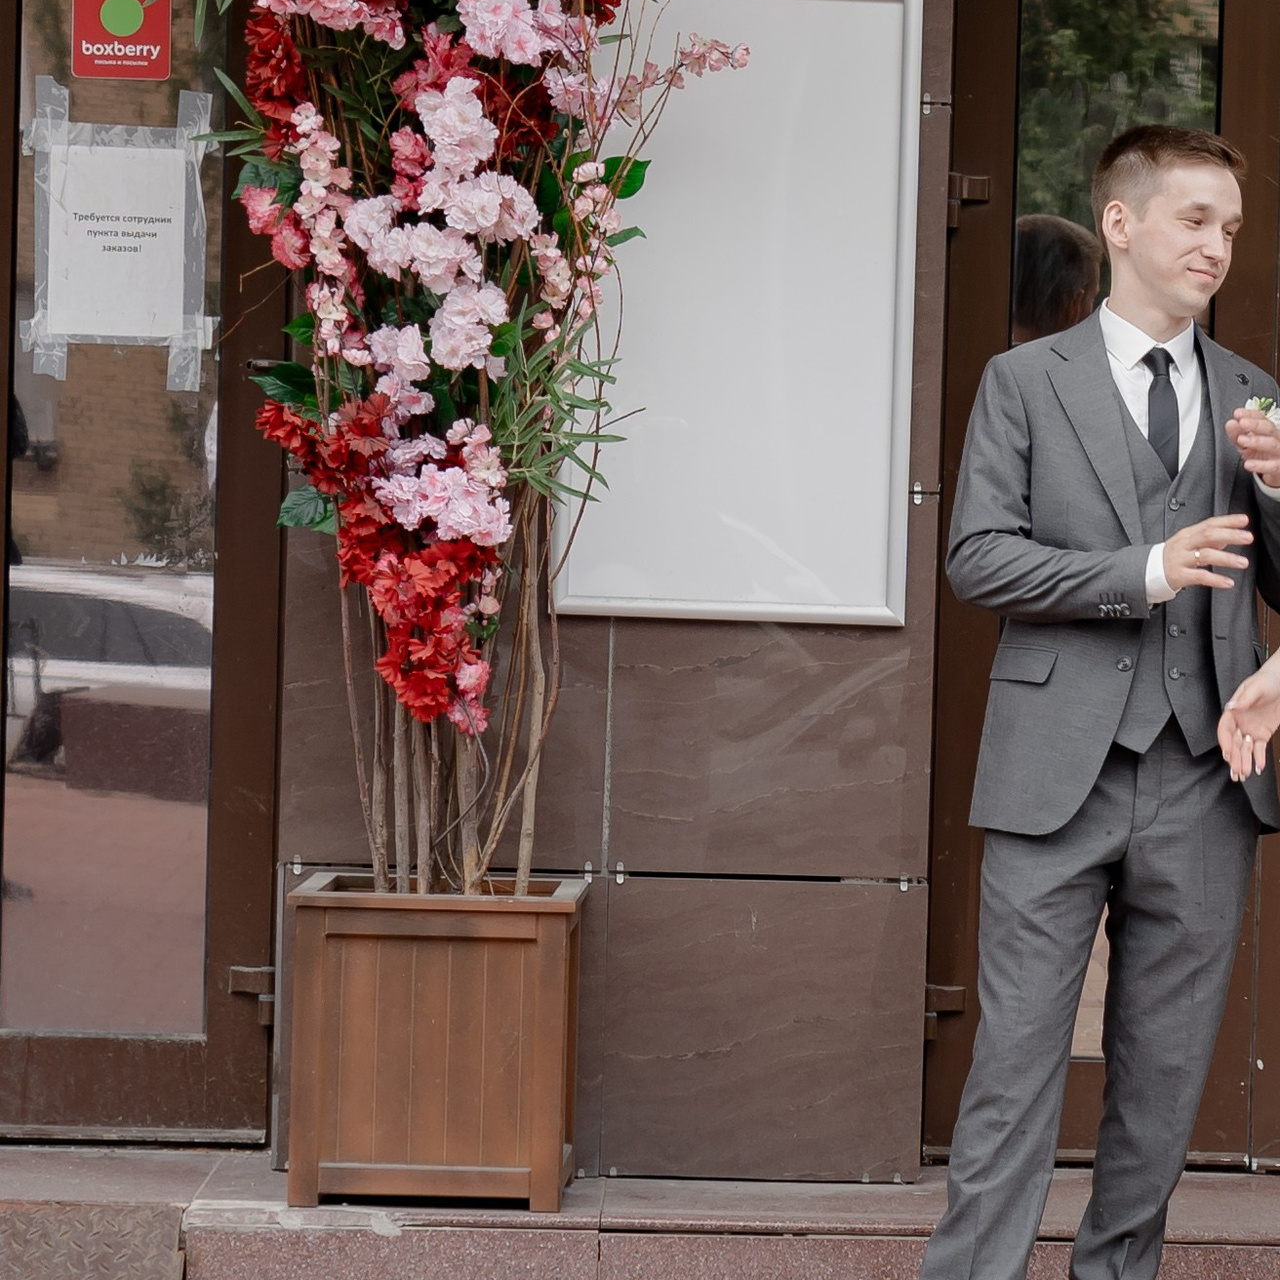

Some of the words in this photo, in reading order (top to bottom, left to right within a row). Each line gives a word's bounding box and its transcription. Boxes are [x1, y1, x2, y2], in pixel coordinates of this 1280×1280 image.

[82, 40, 160, 60] boxberry
[73, 212, 120, 223] Требуется
[122, 215, 172, 224] сотрудник
[87, 229, 118, 238] пункта
[121, 230, 157, 238] выдачи
[101, 244, 141, 253] заказов!
